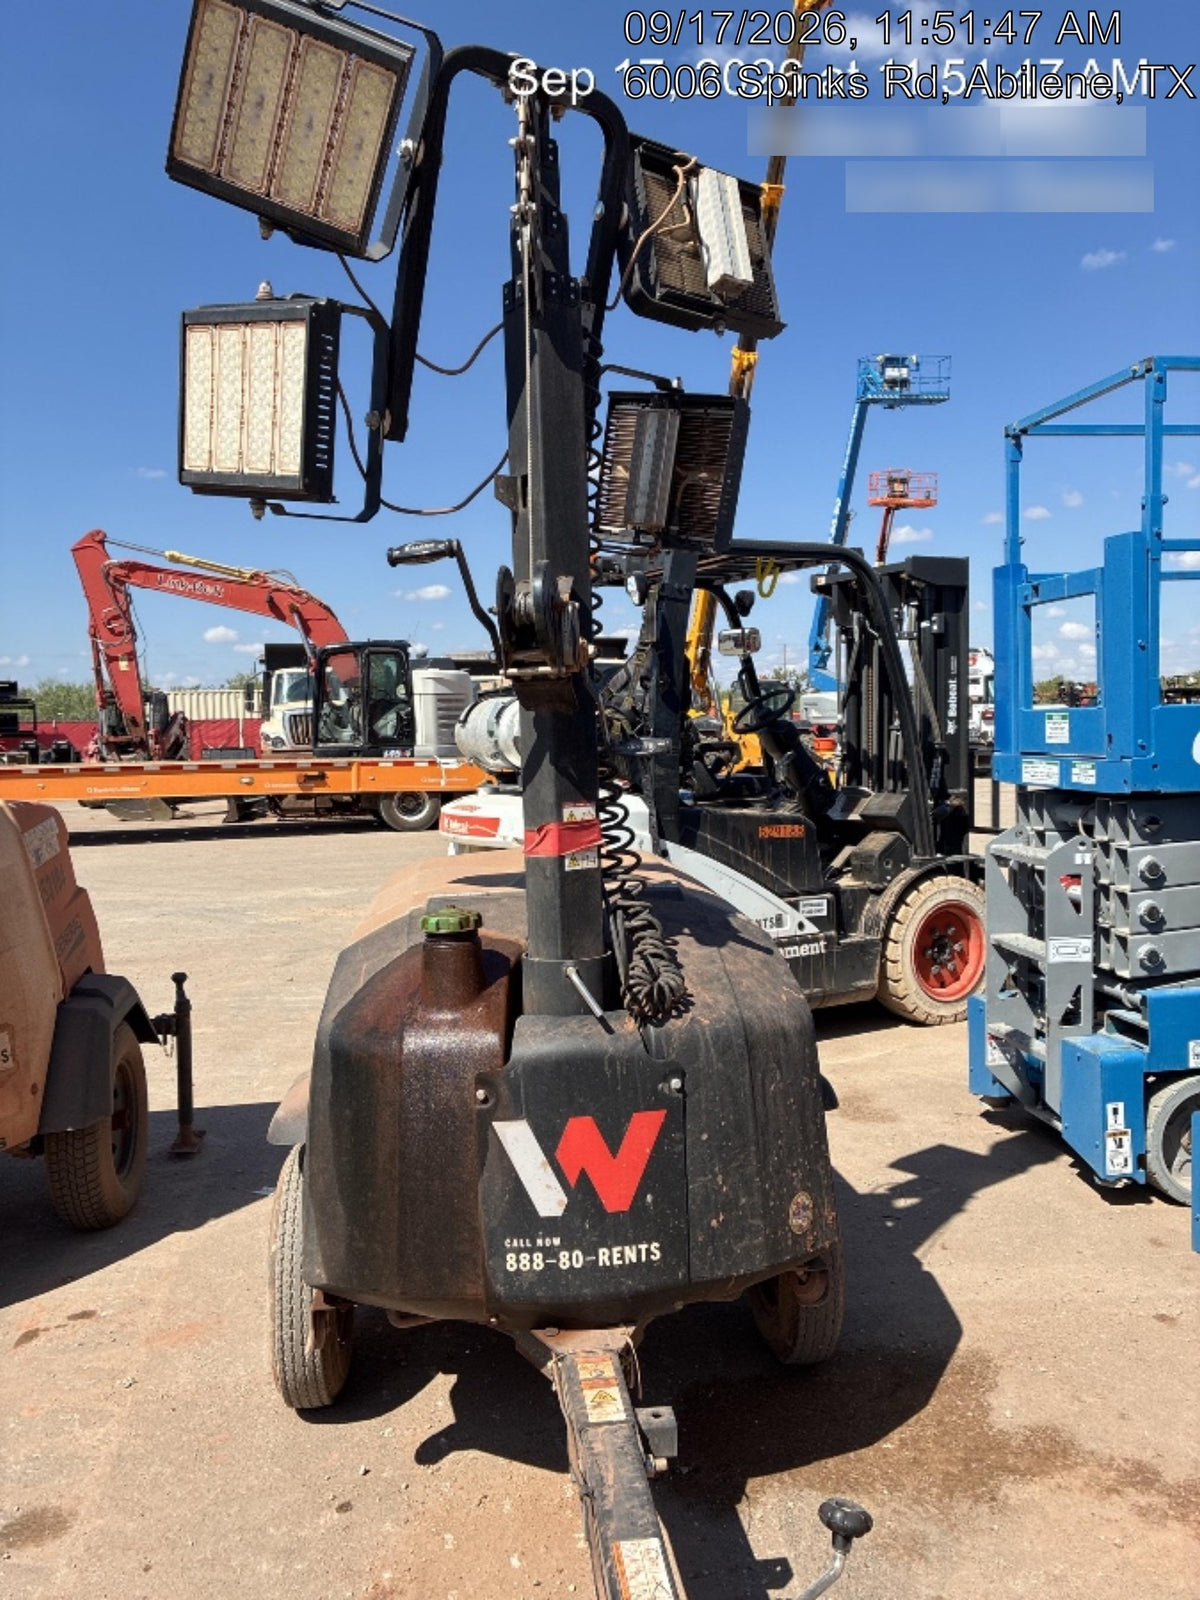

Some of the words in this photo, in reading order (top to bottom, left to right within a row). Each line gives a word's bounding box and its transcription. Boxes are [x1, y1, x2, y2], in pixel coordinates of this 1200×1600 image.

[503, 1237, 533, 1249] CALL
[535, 1235, 562, 1248] NOW
[505, 1242, 662, 1272] 888-80-RENTS
